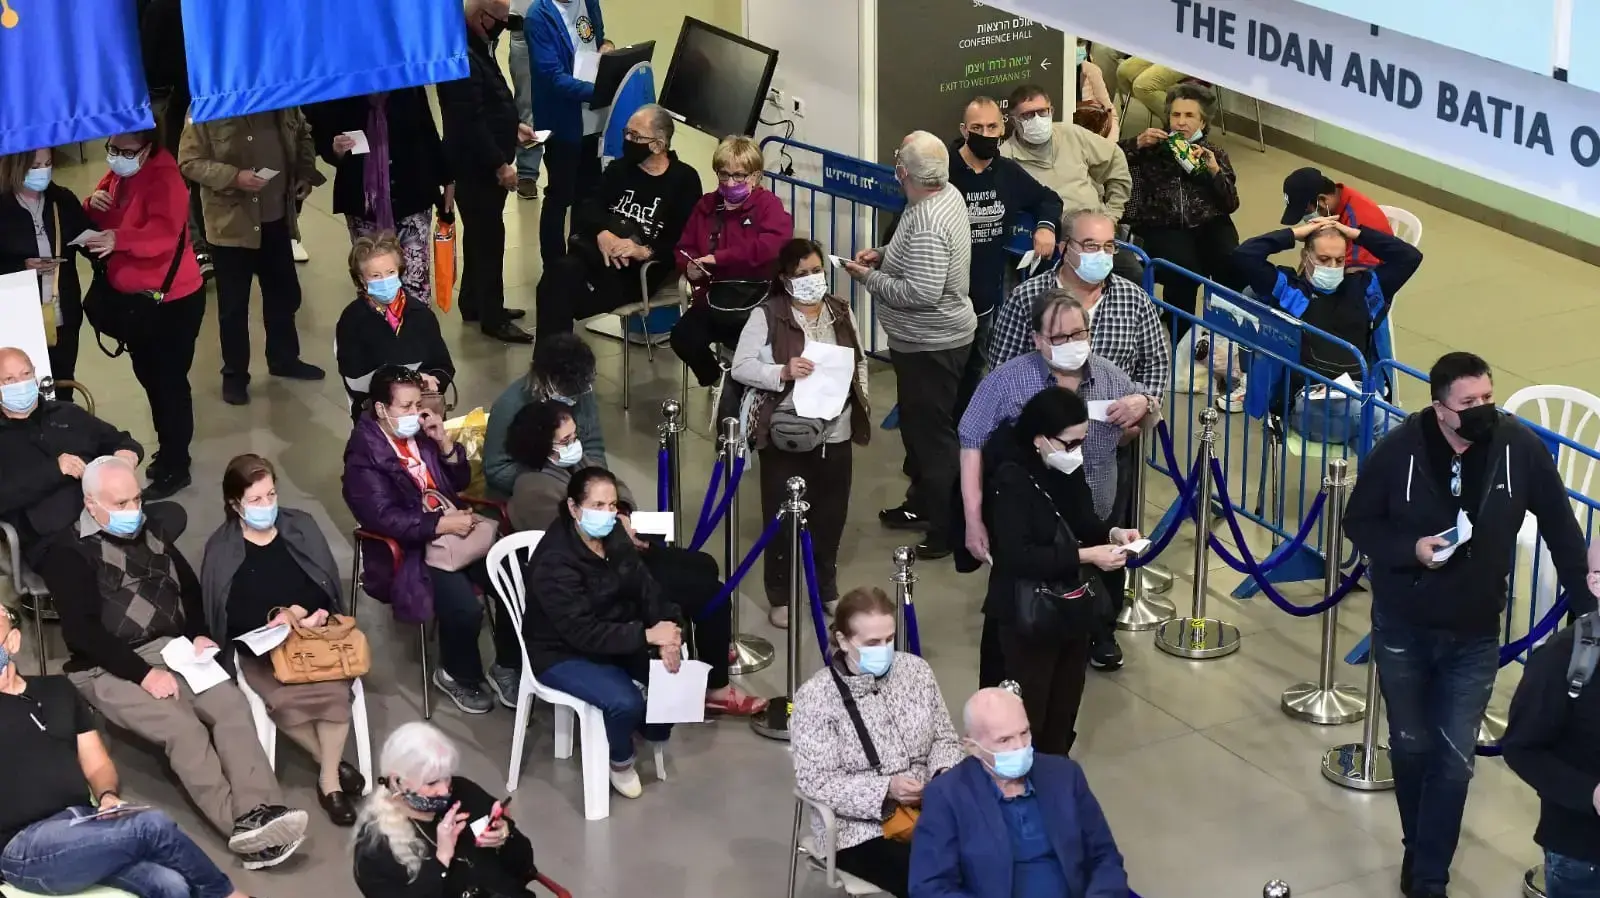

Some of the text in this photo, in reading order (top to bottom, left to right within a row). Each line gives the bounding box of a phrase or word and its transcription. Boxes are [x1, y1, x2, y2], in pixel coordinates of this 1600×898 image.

[976, 20, 1010, 34] הרצאות
[959, 30, 1033, 49] CONFERENCE HALL
[965, 62, 985, 77] ויצמן
[1008, 55, 1032, 68] יציאה
[940, 81, 958, 92] EXIT
[960, 79, 969, 89] TO
[971, 72, 1020, 87] WEITZMANN
[1170, 0, 1600, 168] THE IDAN AND BATIA O
